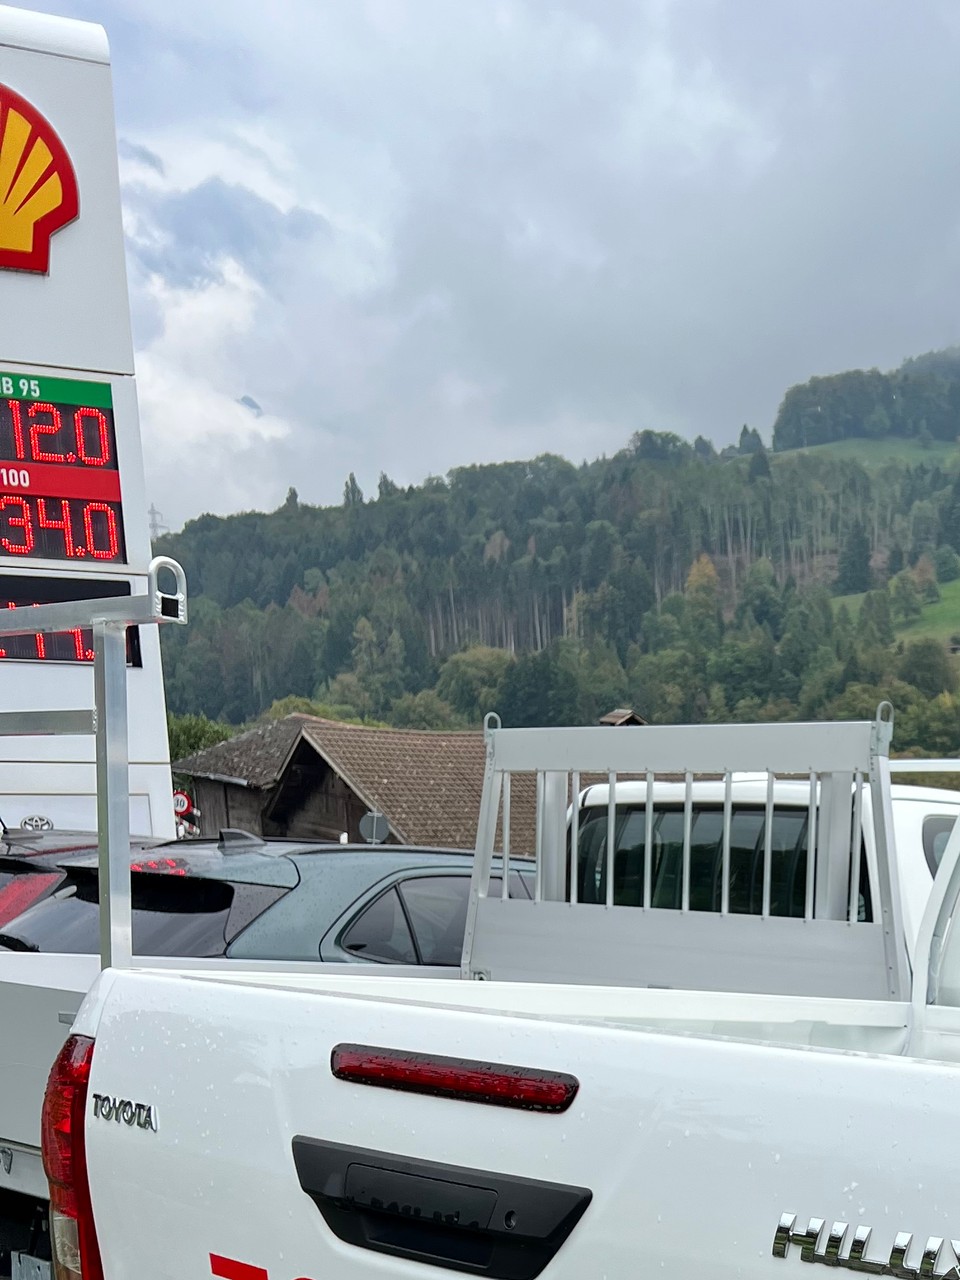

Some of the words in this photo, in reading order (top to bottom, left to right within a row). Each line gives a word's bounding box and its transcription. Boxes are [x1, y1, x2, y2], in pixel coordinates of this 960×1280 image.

[0, 377, 13, 395] B
[19, 379, 40, 397] 95
[1, 468, 30, 488] 100
[92, 1093, 158, 1133] TOYOTA
